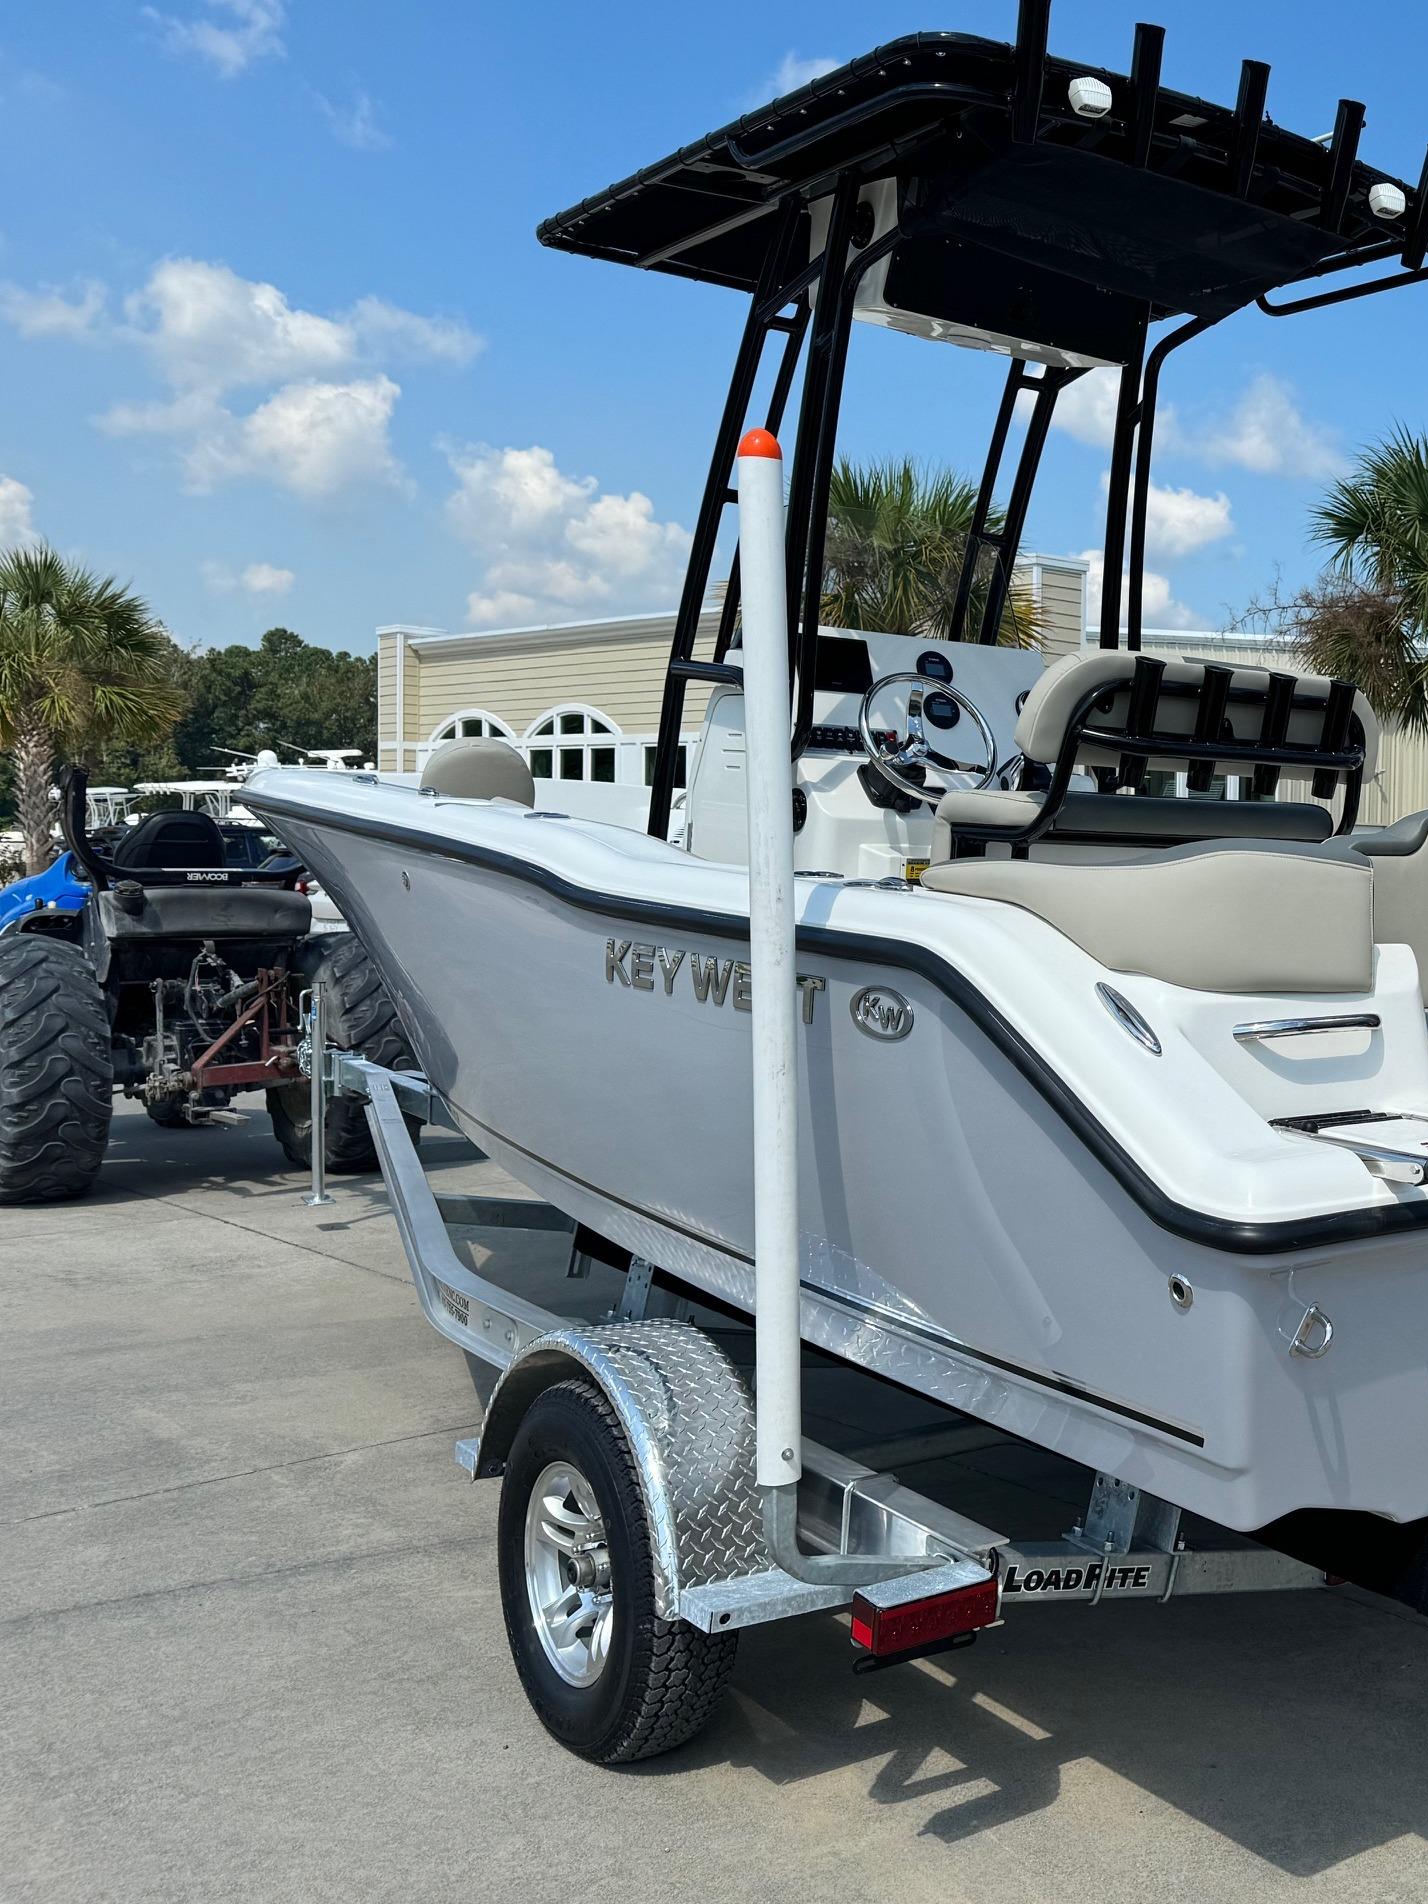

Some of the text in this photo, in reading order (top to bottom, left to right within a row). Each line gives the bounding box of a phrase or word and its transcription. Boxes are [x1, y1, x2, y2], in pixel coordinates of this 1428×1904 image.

[186, 872, 229, 881] BOOMER
[605, 938, 826, 1025] KEY WET
[862, 994, 904, 1031] KW
